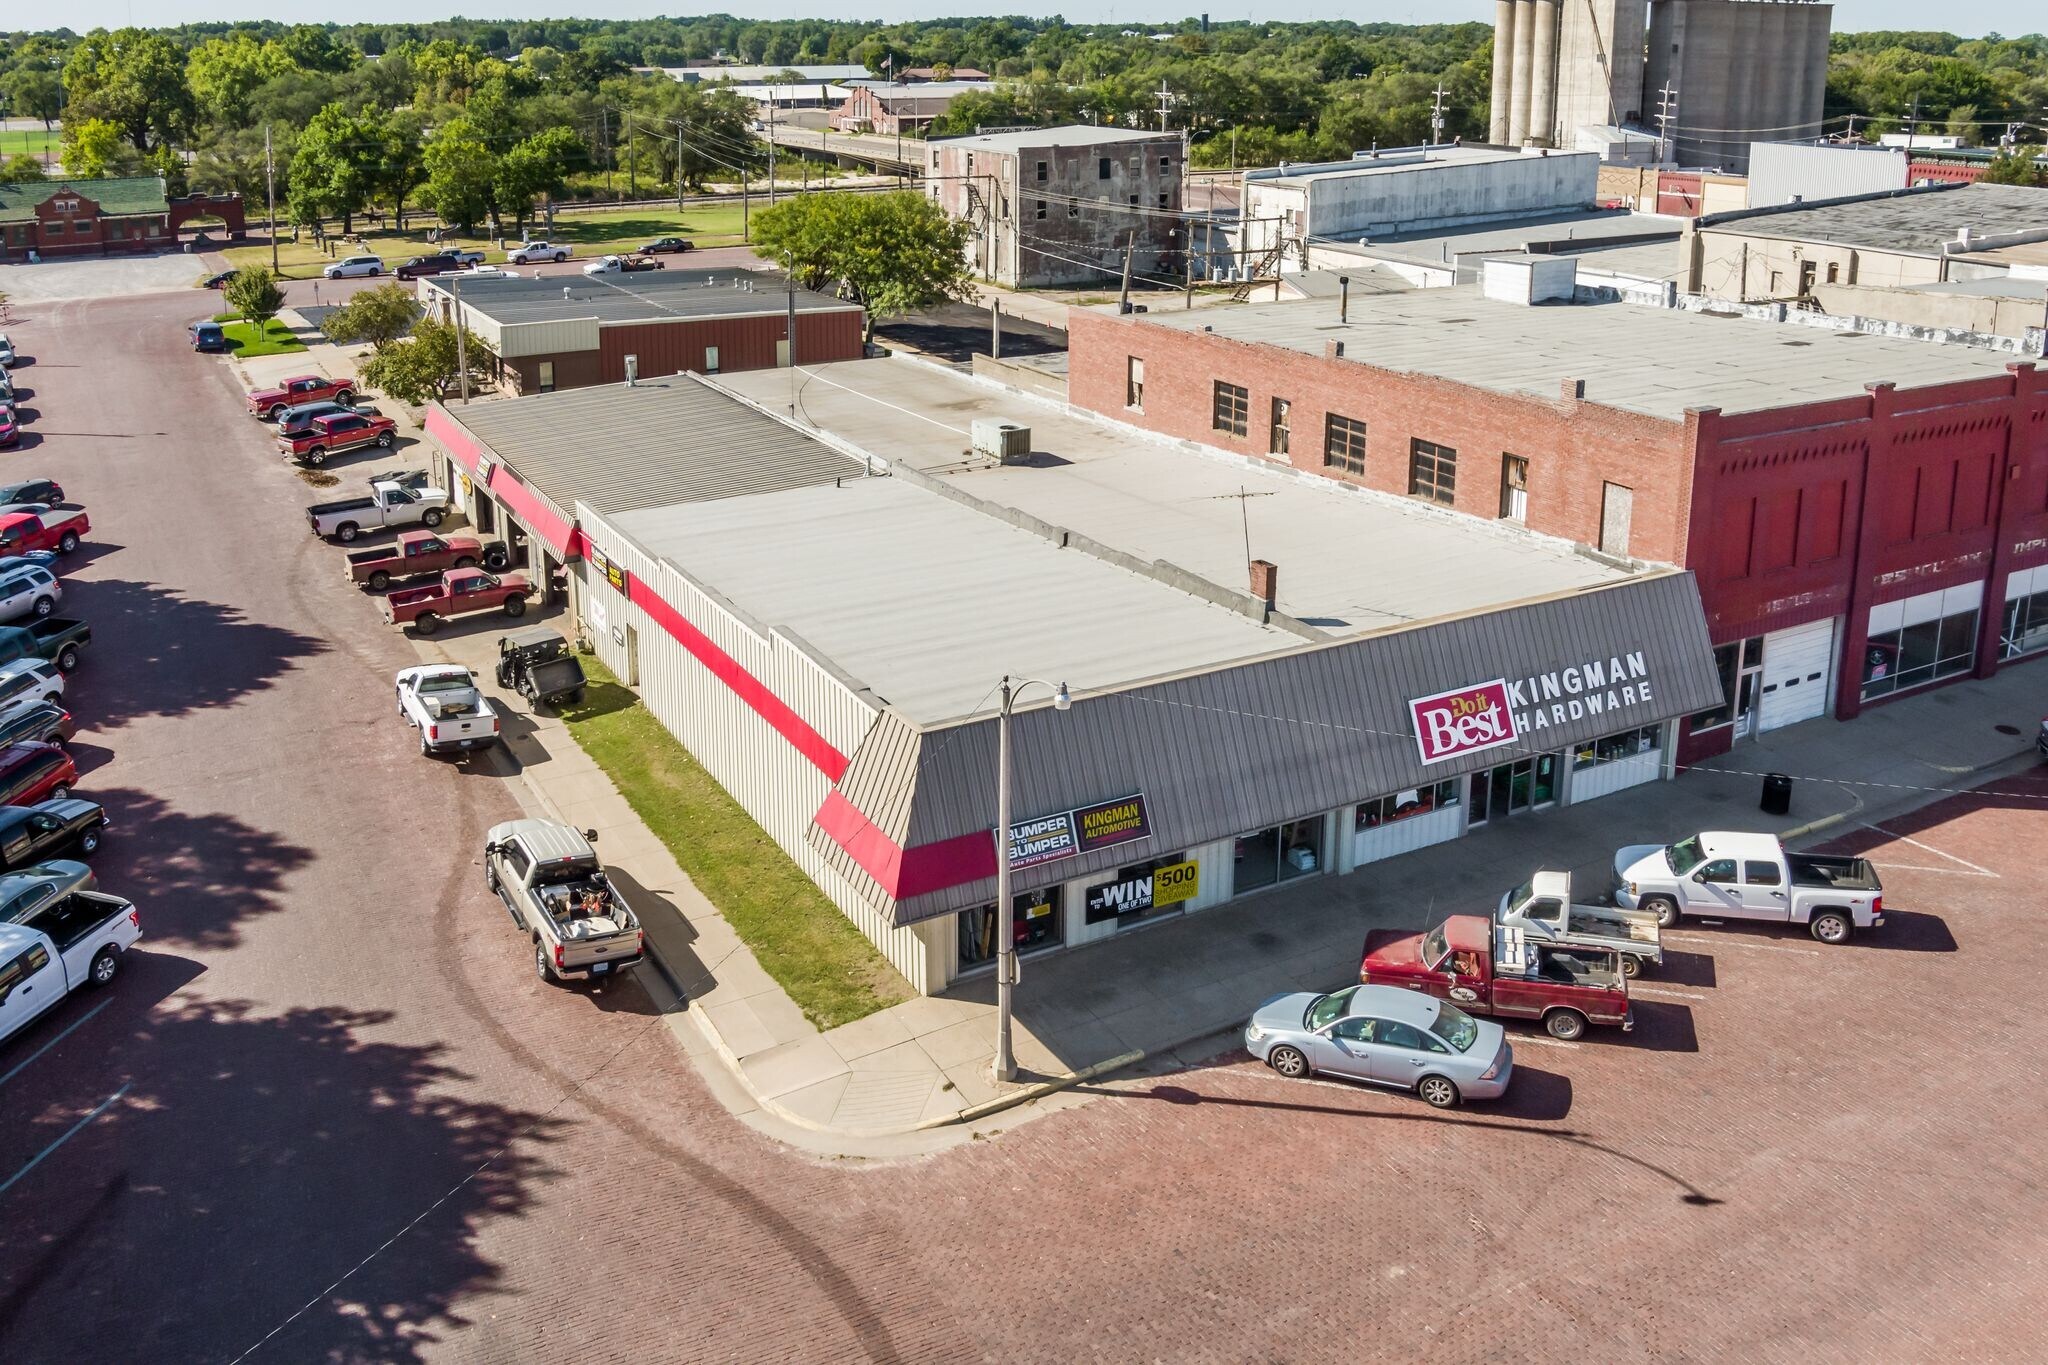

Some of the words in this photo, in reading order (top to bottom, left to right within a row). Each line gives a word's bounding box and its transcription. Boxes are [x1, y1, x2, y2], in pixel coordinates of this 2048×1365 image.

[1507, 651, 1647, 708] KINGMAN
[1449, 697, 1476, 718] Do
[1475, 692, 1490, 711] it
[1514, 681, 1652, 734] HARDWARE
[1422, 700, 1507, 755] Best
[1009, 816, 1068, 839] BUMPER
[1084, 803, 1139, 829] KINGMAN
[1085, 817, 1142, 839] AUTOMOTIVE
[1009, 834, 1071, 859] BUMPER
[1010, 860, 1025, 868] Auto
[1026, 855, 1041, 864] Parts
[1042, 848, 1072, 861] Specialists
[1156, 866, 1196, 887] $500
[1103, 876, 1152, 907] WIN
[1155, 888, 1195, 904] GIVEAWAY
[1156, 881, 1195, 897] SHOPPING
[1118, 901, 1129, 911] ONE
[1130, 900, 1138, 908] OF
[1139, 896, 1152, 905] TWO
